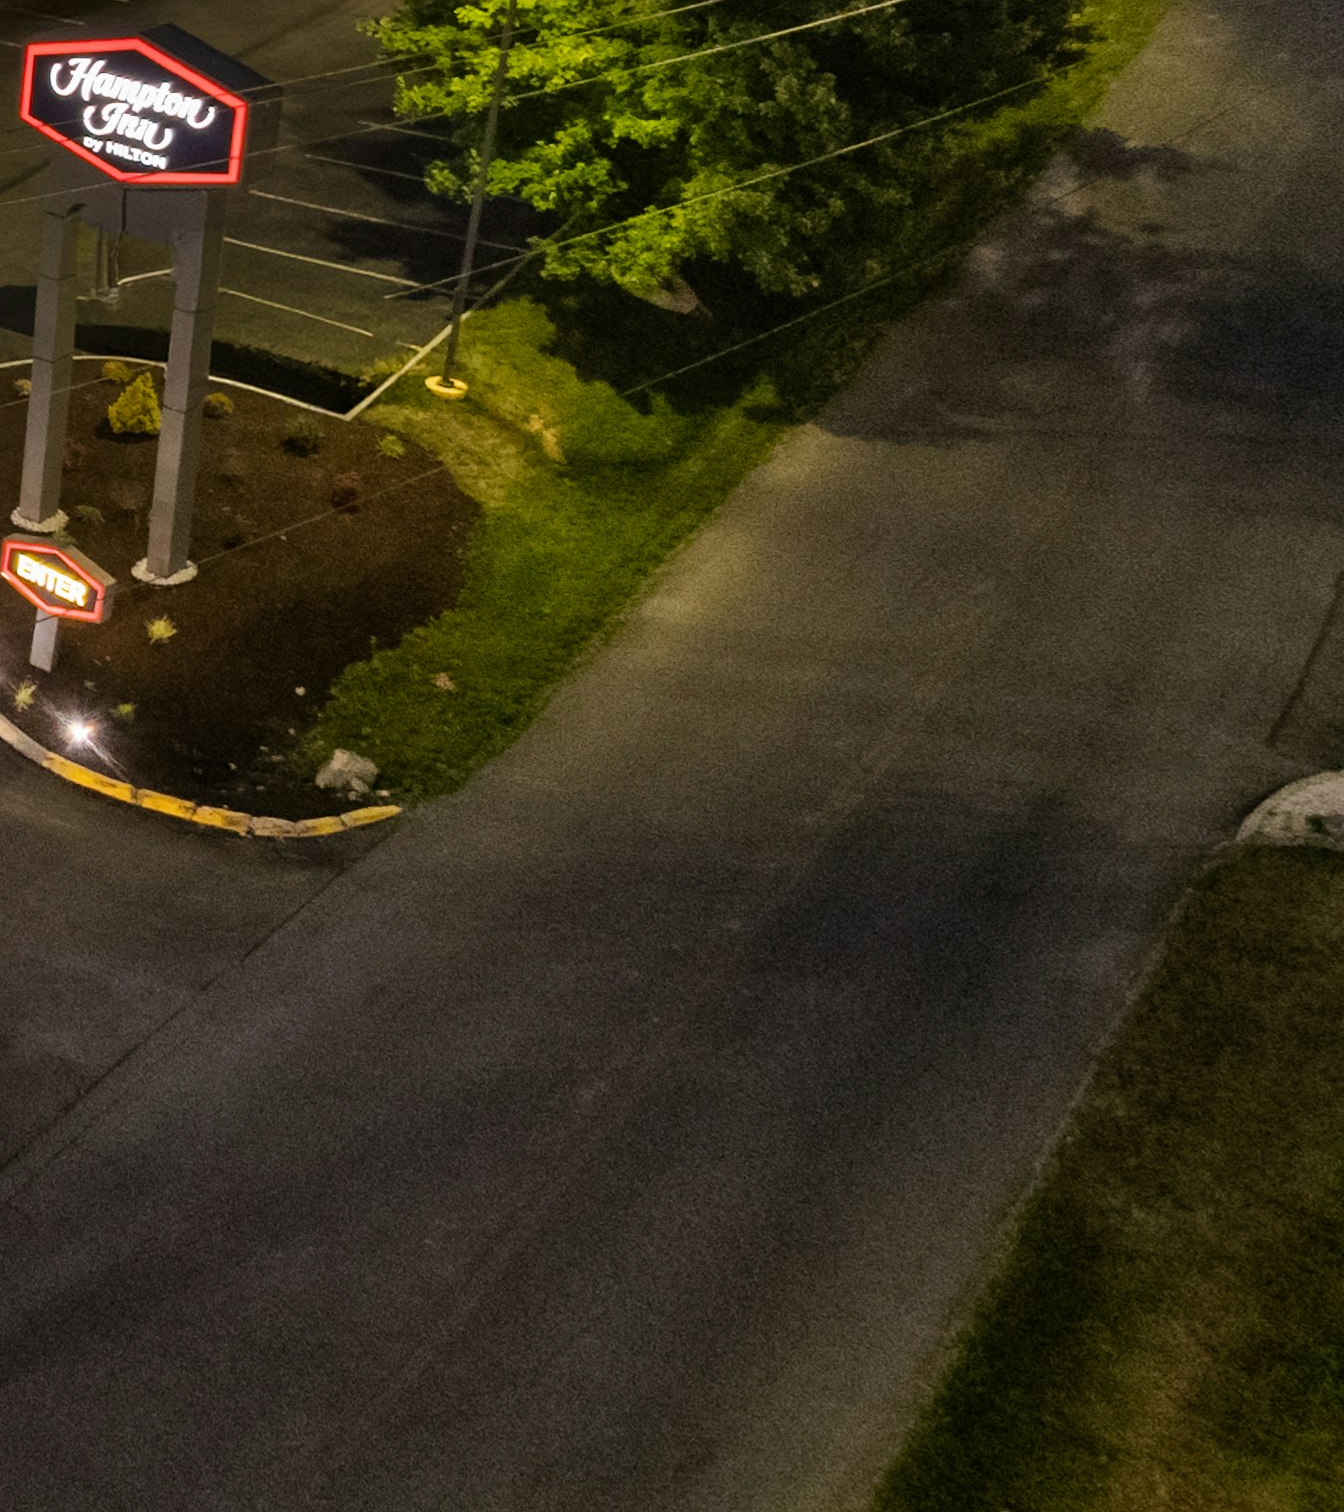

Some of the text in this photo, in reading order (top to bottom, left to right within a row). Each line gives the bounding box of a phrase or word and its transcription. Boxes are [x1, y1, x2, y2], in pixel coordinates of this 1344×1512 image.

[49, 57, 216, 130] Hampton
[82, 102, 175, 151] Inn
[105, 140, 168, 170] HILTON
[16, 552, 88, 608] ENTER
